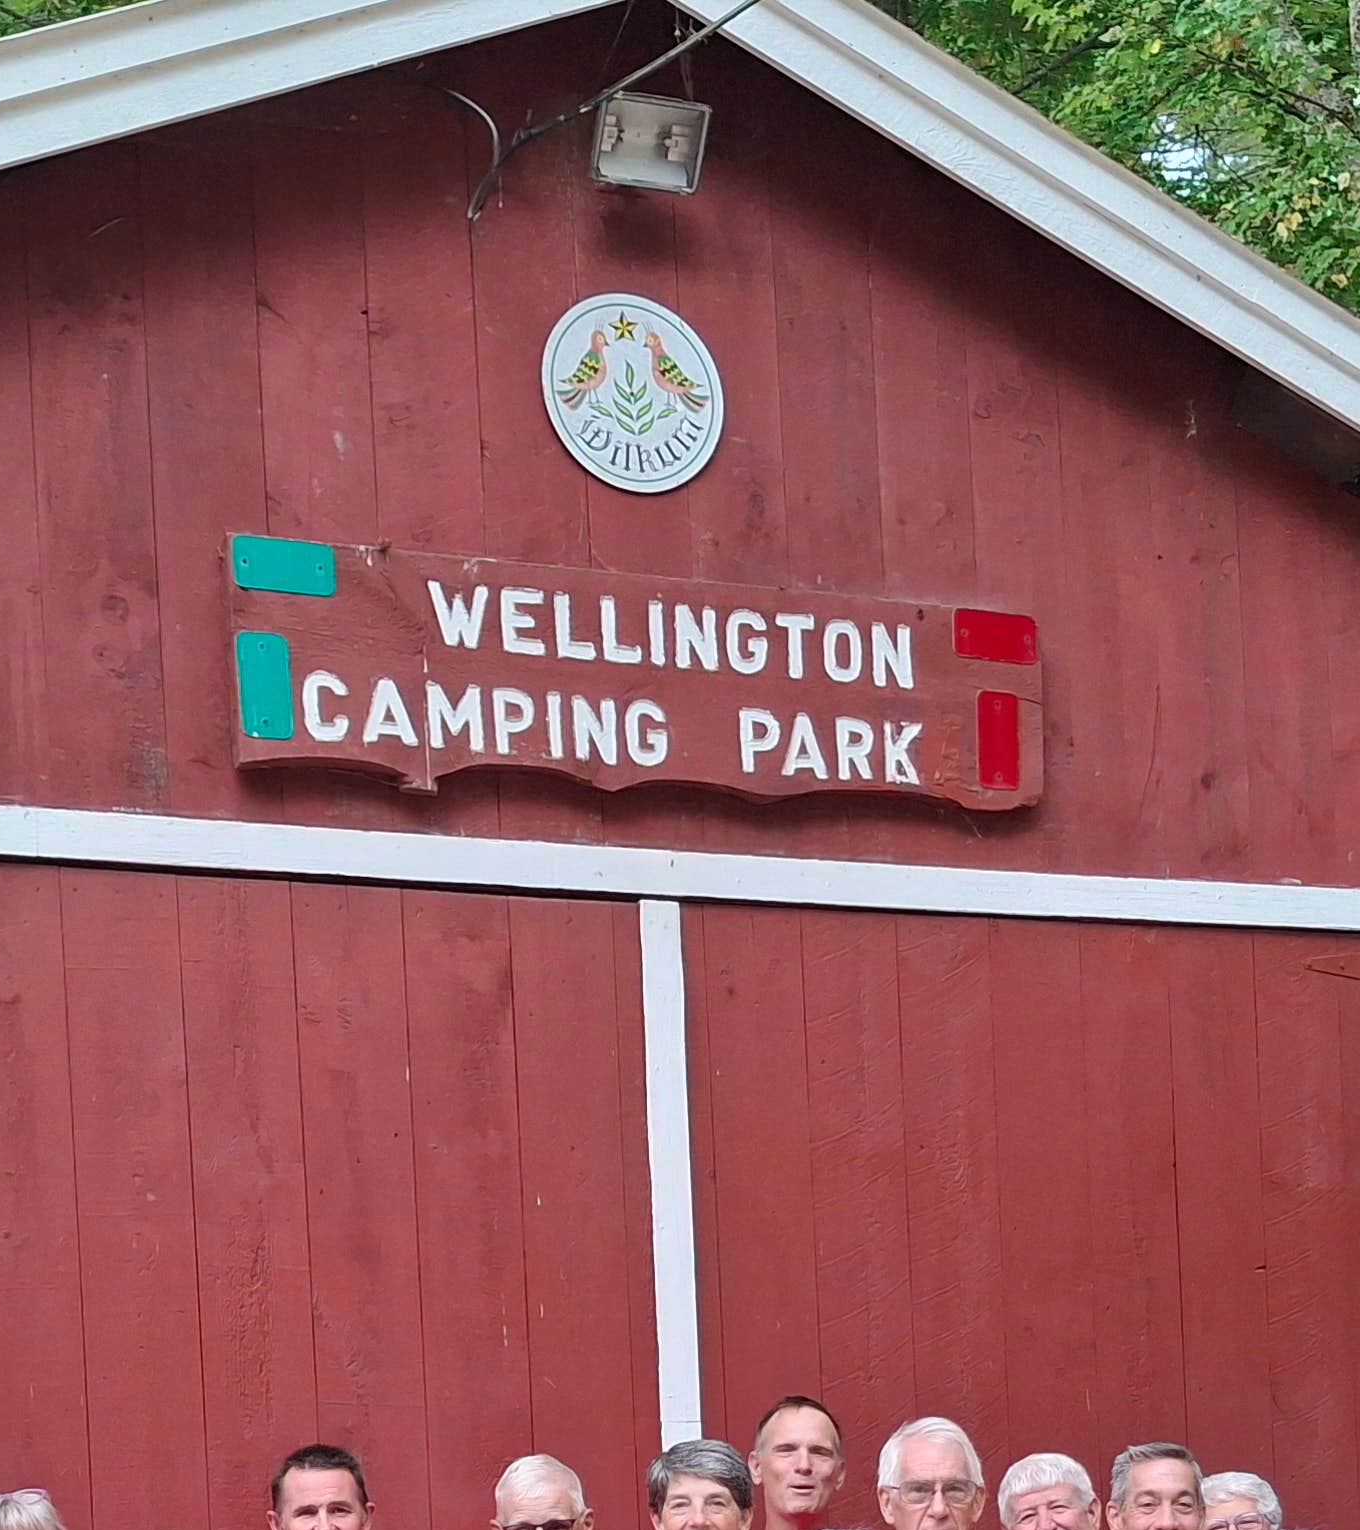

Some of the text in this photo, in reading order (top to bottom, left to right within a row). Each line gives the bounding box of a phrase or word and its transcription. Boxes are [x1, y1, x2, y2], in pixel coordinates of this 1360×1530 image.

[427, 579, 916, 690] WELLINGTON
[302, 669, 923, 786] CAMPING PARK
